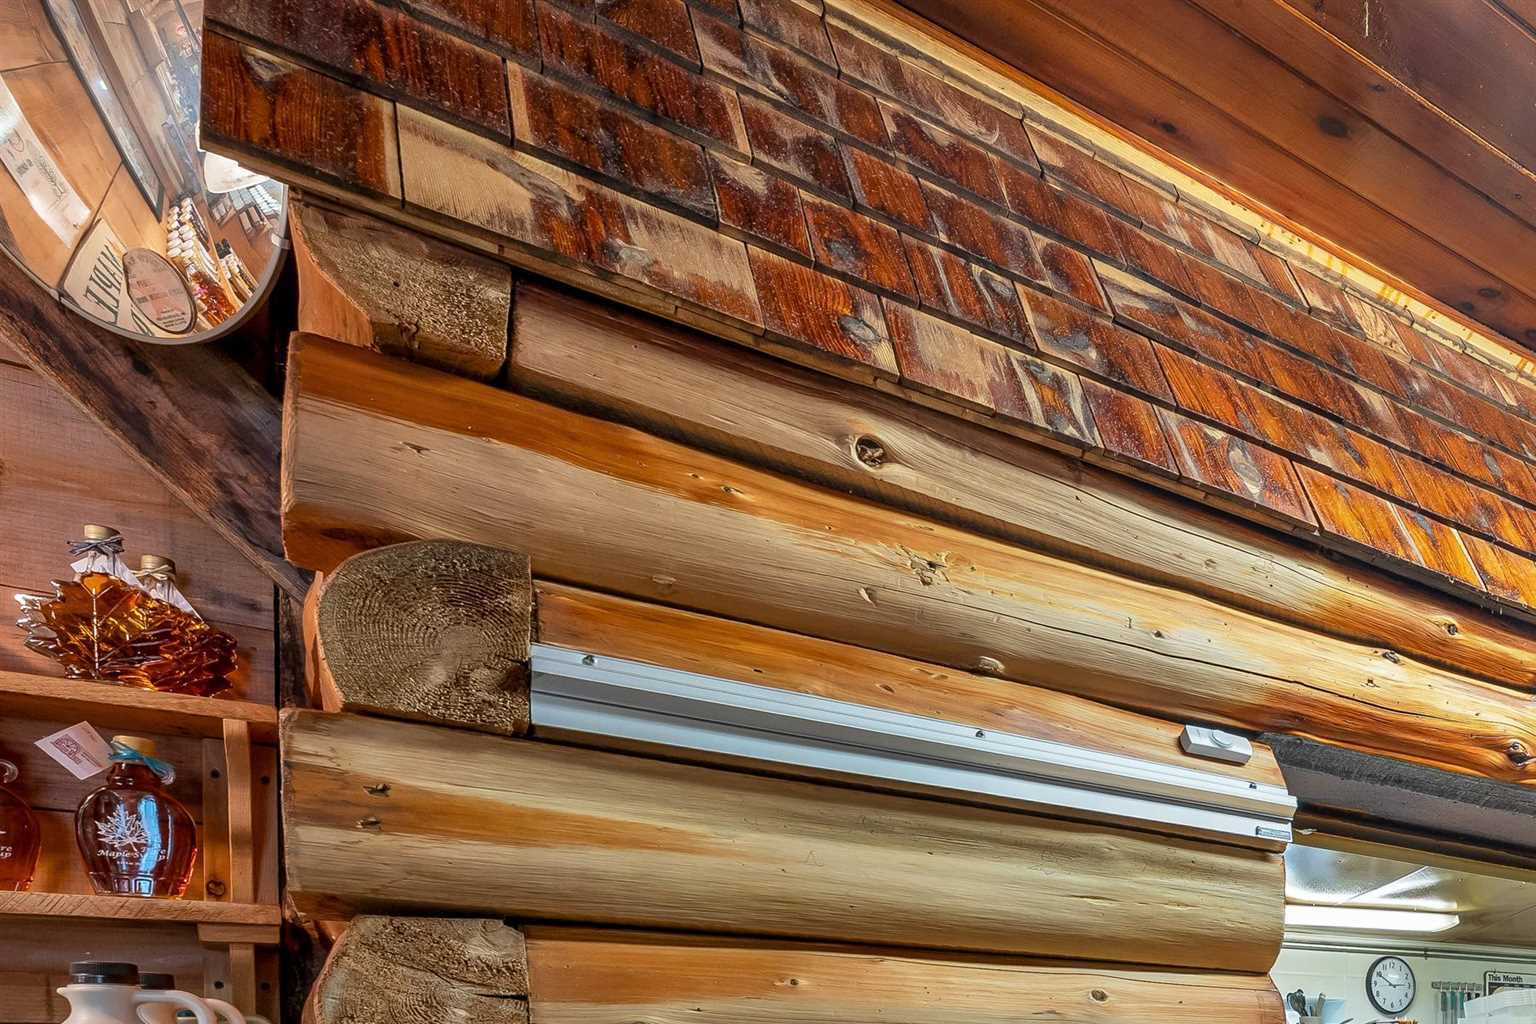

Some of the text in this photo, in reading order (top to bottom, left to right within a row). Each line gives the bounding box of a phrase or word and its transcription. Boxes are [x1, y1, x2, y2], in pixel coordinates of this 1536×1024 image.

[97, 849, 130, 859] Maple
[1488, 973, 1523, 983] This Month
